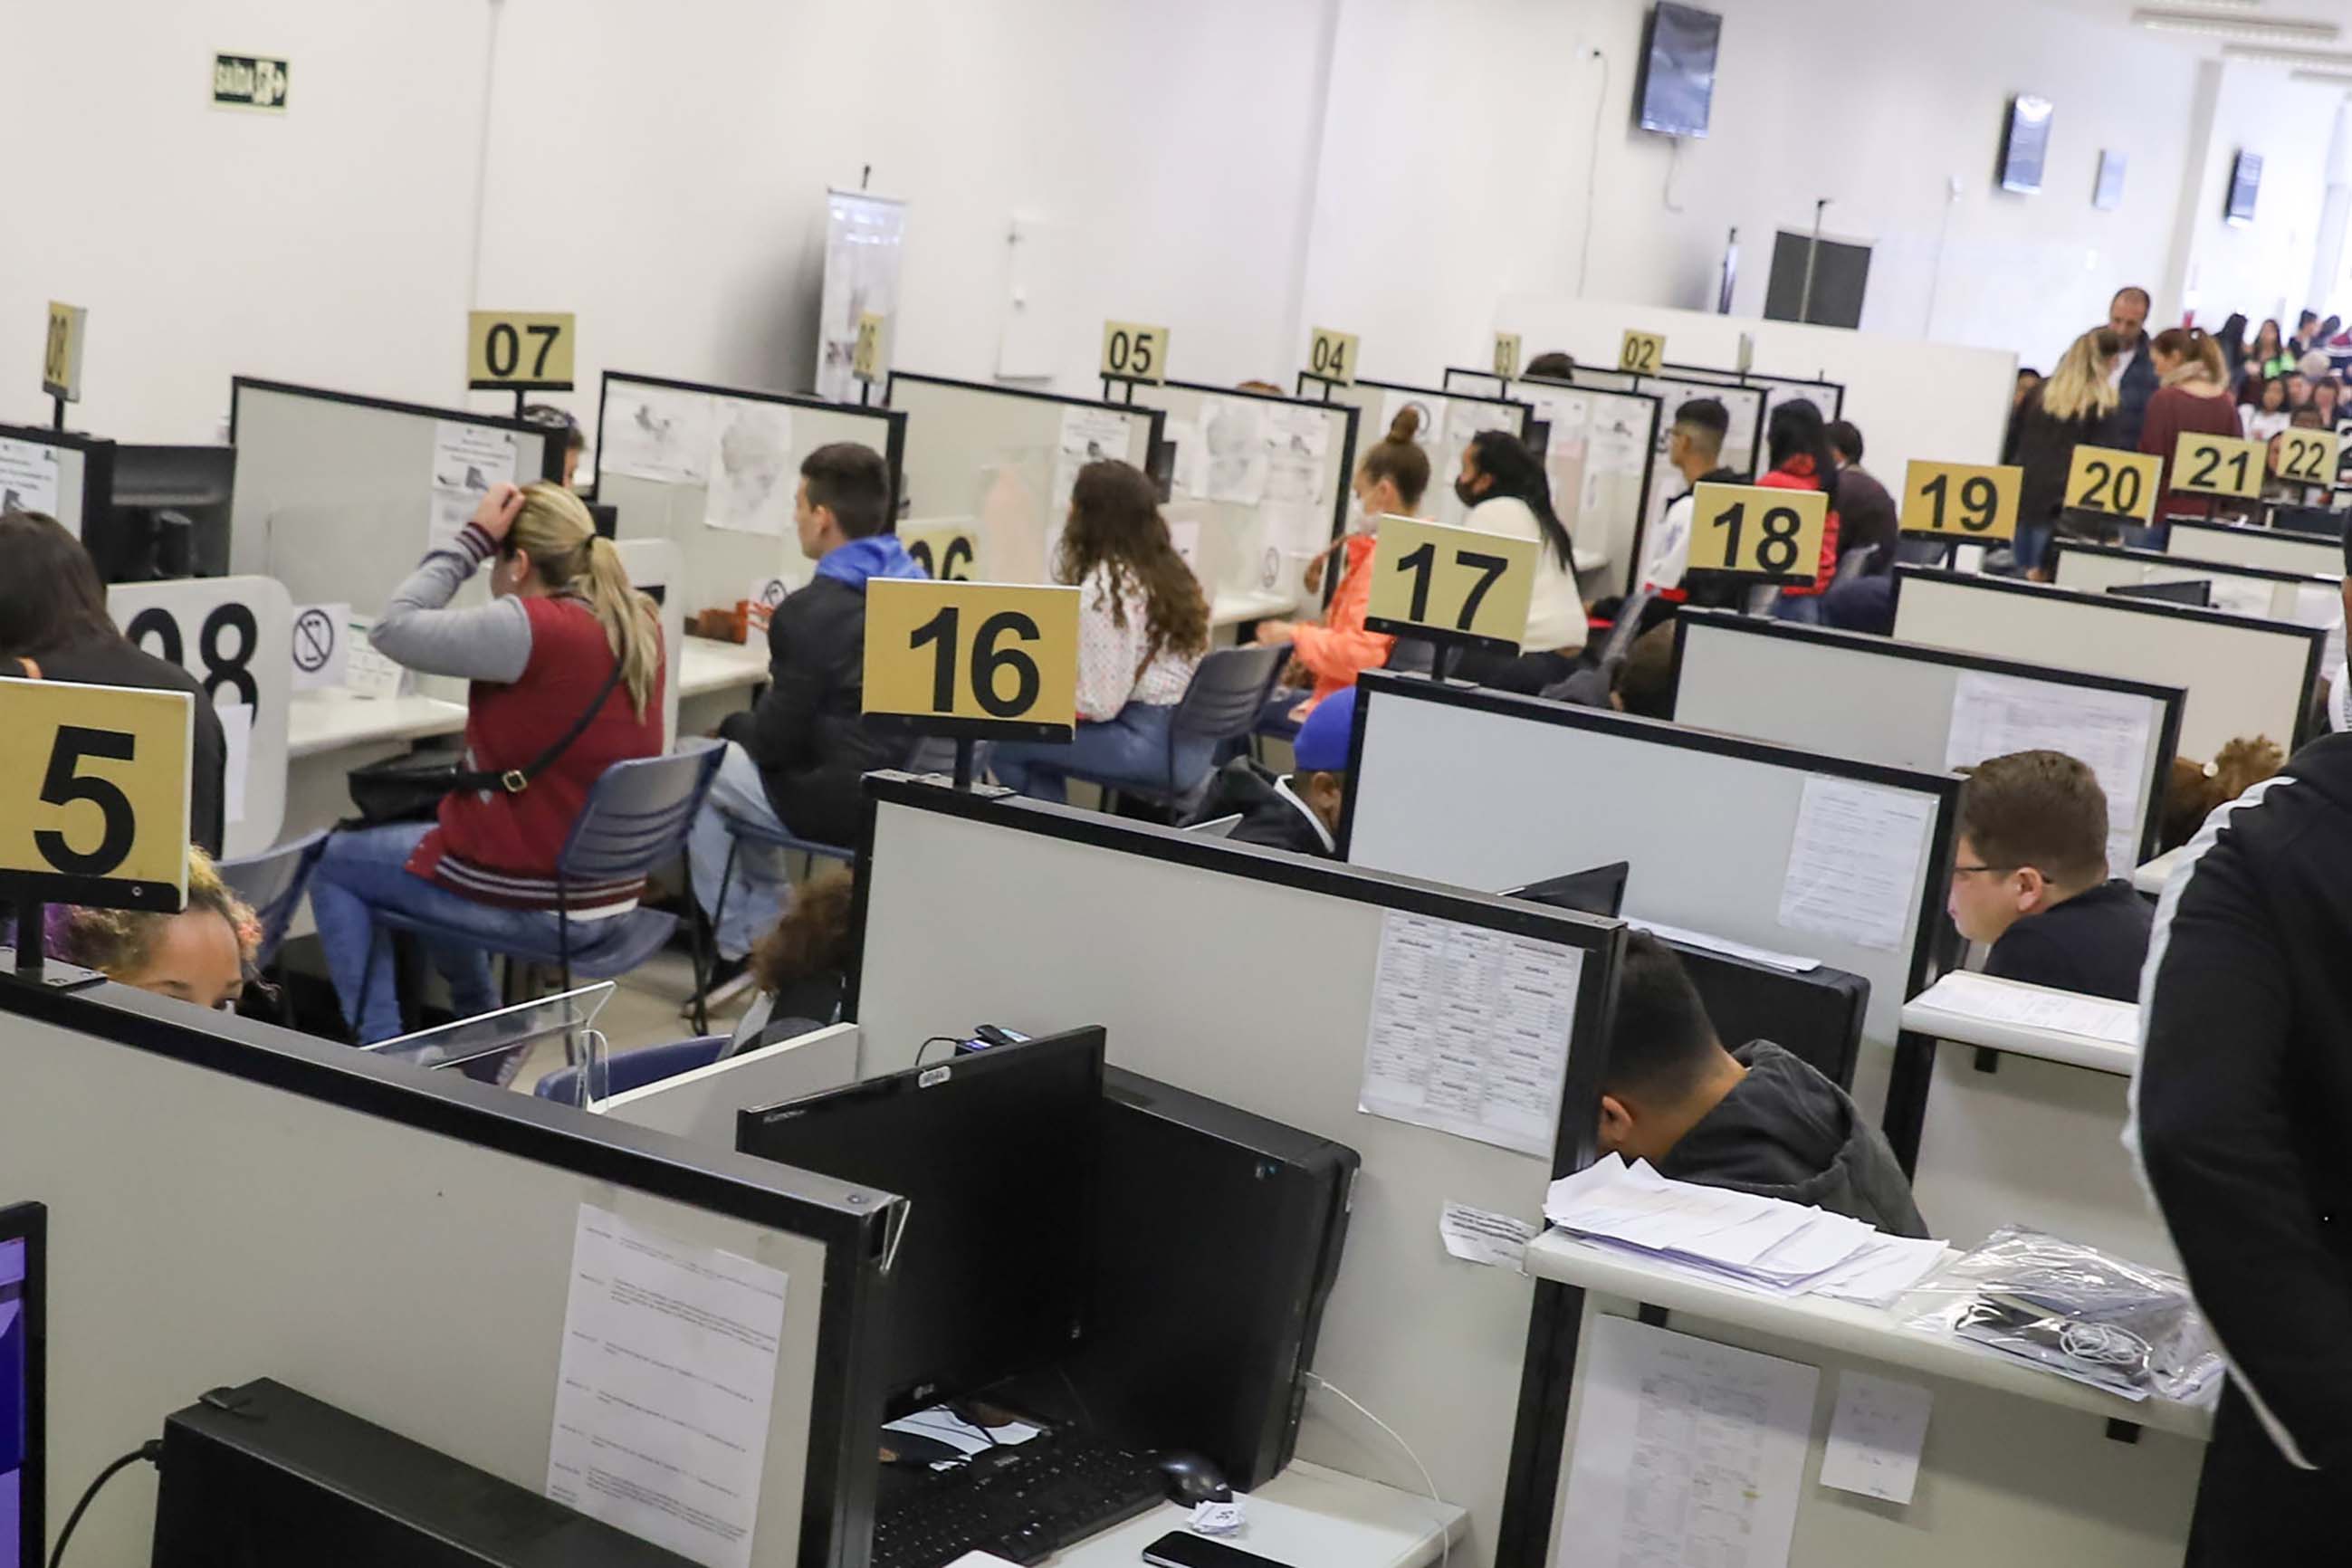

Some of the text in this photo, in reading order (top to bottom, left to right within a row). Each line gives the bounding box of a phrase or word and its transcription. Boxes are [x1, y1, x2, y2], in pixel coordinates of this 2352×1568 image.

[485, 323, 560, 378] 07
[1109, 330, 1152, 374] 05
[1312, 336, 1345, 374] 04
[1624, 338, 1655, 369] 02
[2188, 446, 2250, 492] 21
[2286, 439, 2325, 478] 22
[1920, 473, 1998, 531] 19
[2080, 462, 2140, 513] 20
[1713, 502, 1801, 573] 18
[1397, 543, 1508, 631] 17
[910, 607, 1041, 718] 16
[33, 724, 136, 877] 5
